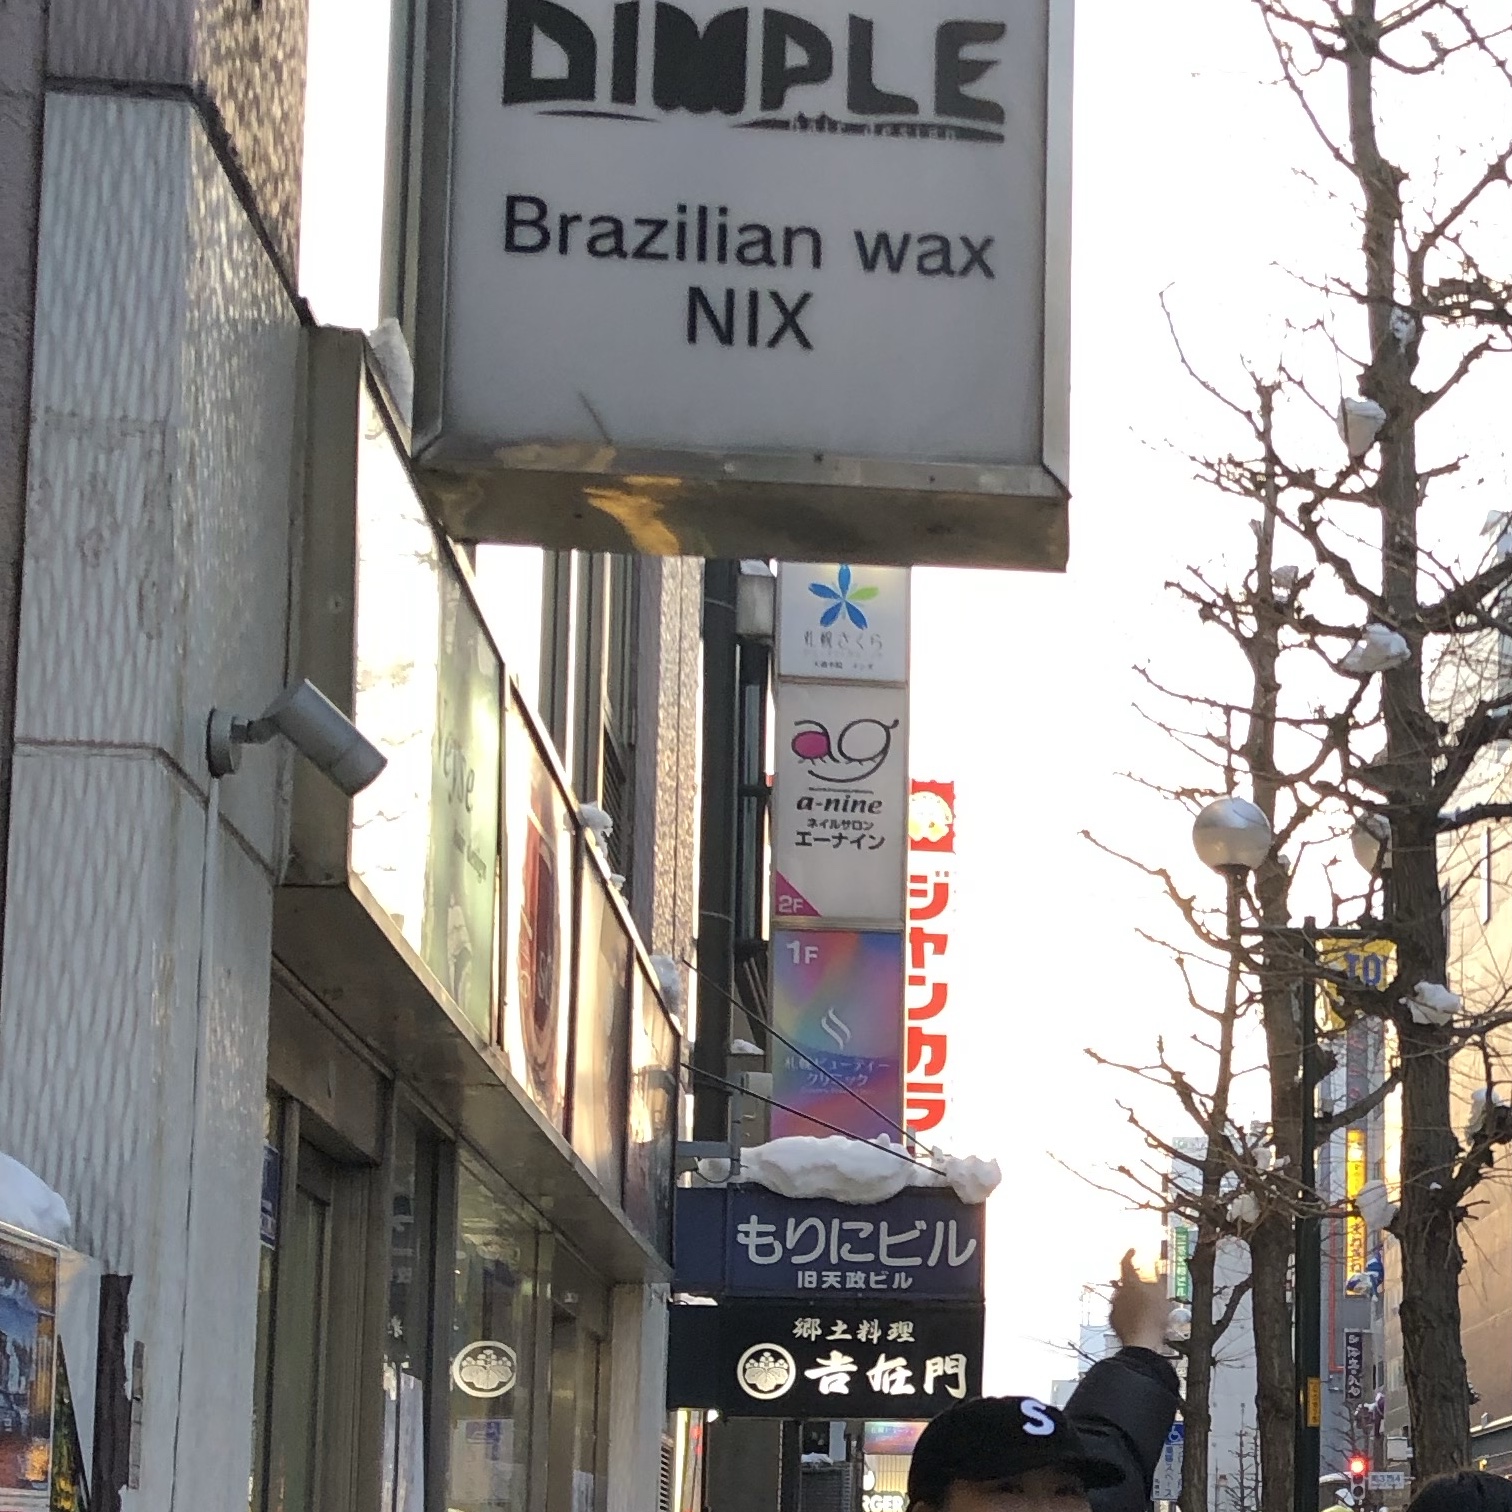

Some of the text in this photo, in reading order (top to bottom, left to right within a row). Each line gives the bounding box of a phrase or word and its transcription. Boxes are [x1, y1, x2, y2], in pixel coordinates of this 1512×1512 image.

[502, 0, 1006, 124] DIMPLE
[503, 194, 996, 280] Brazilian wax
[686, 286, 814, 353] NIX
[797, 794, 883, 815] a-nine
[807, 818, 874, 832] ネイルサロン
[795, 832, 886, 851] エーナイン
[778, 896, 804, 914] 2F
[786, 940, 819, 964] 1F
[737, 1215, 977, 1267] もりにビル
[797, 1271, 913, 1290] 旧天政ビル
[792, 1317, 916, 1344] 郷土料理
[1021, 1400, 1055, 1436] S
